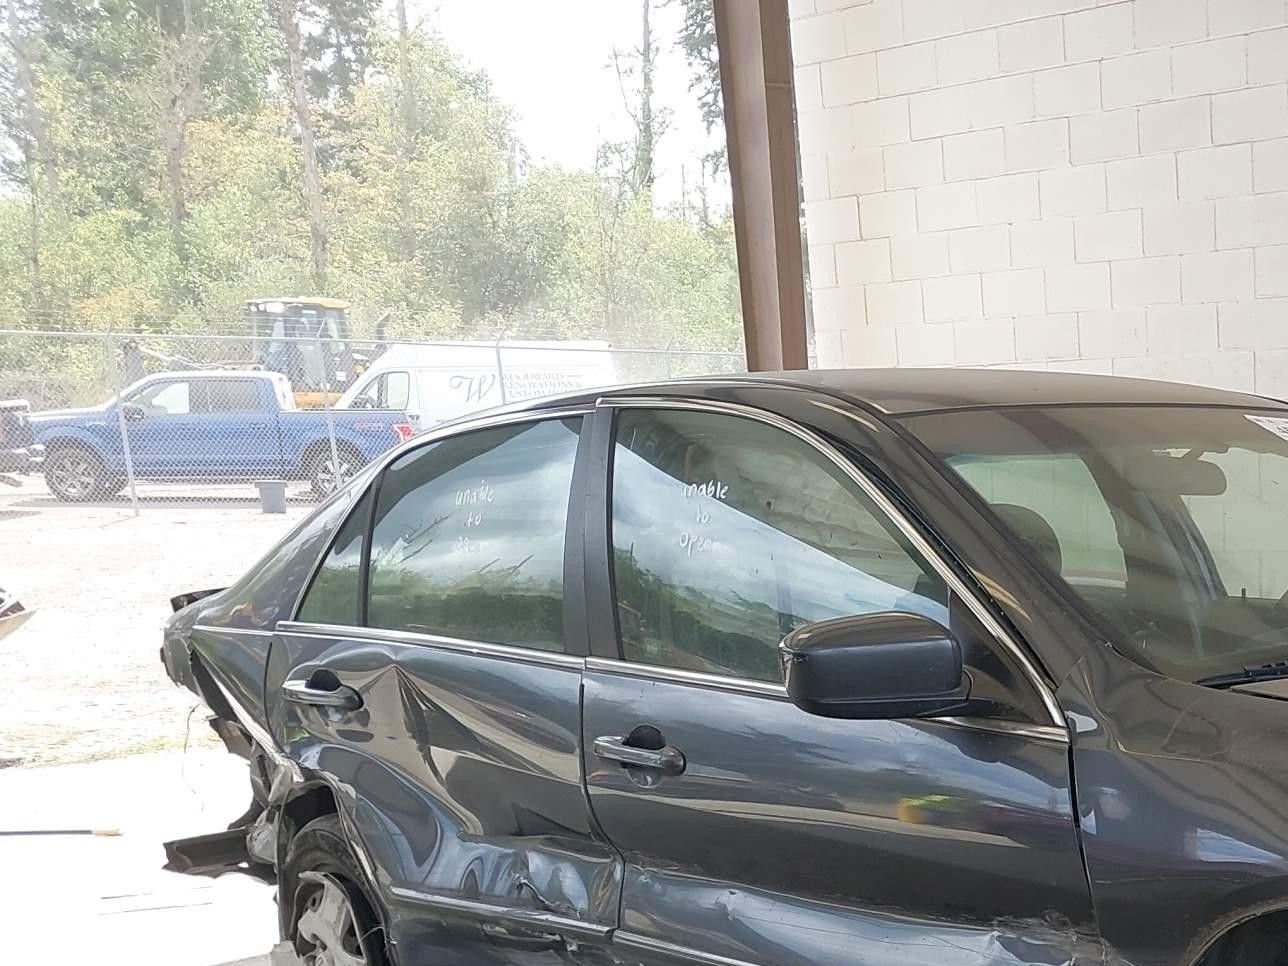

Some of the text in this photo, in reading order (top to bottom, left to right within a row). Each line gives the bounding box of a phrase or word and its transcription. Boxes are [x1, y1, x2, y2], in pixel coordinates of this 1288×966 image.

[455, 480, 495, 506] unable
[680, 480, 729, 499] unable
[467, 512, 482, 528] to
[697, 504, 710, 524] to
